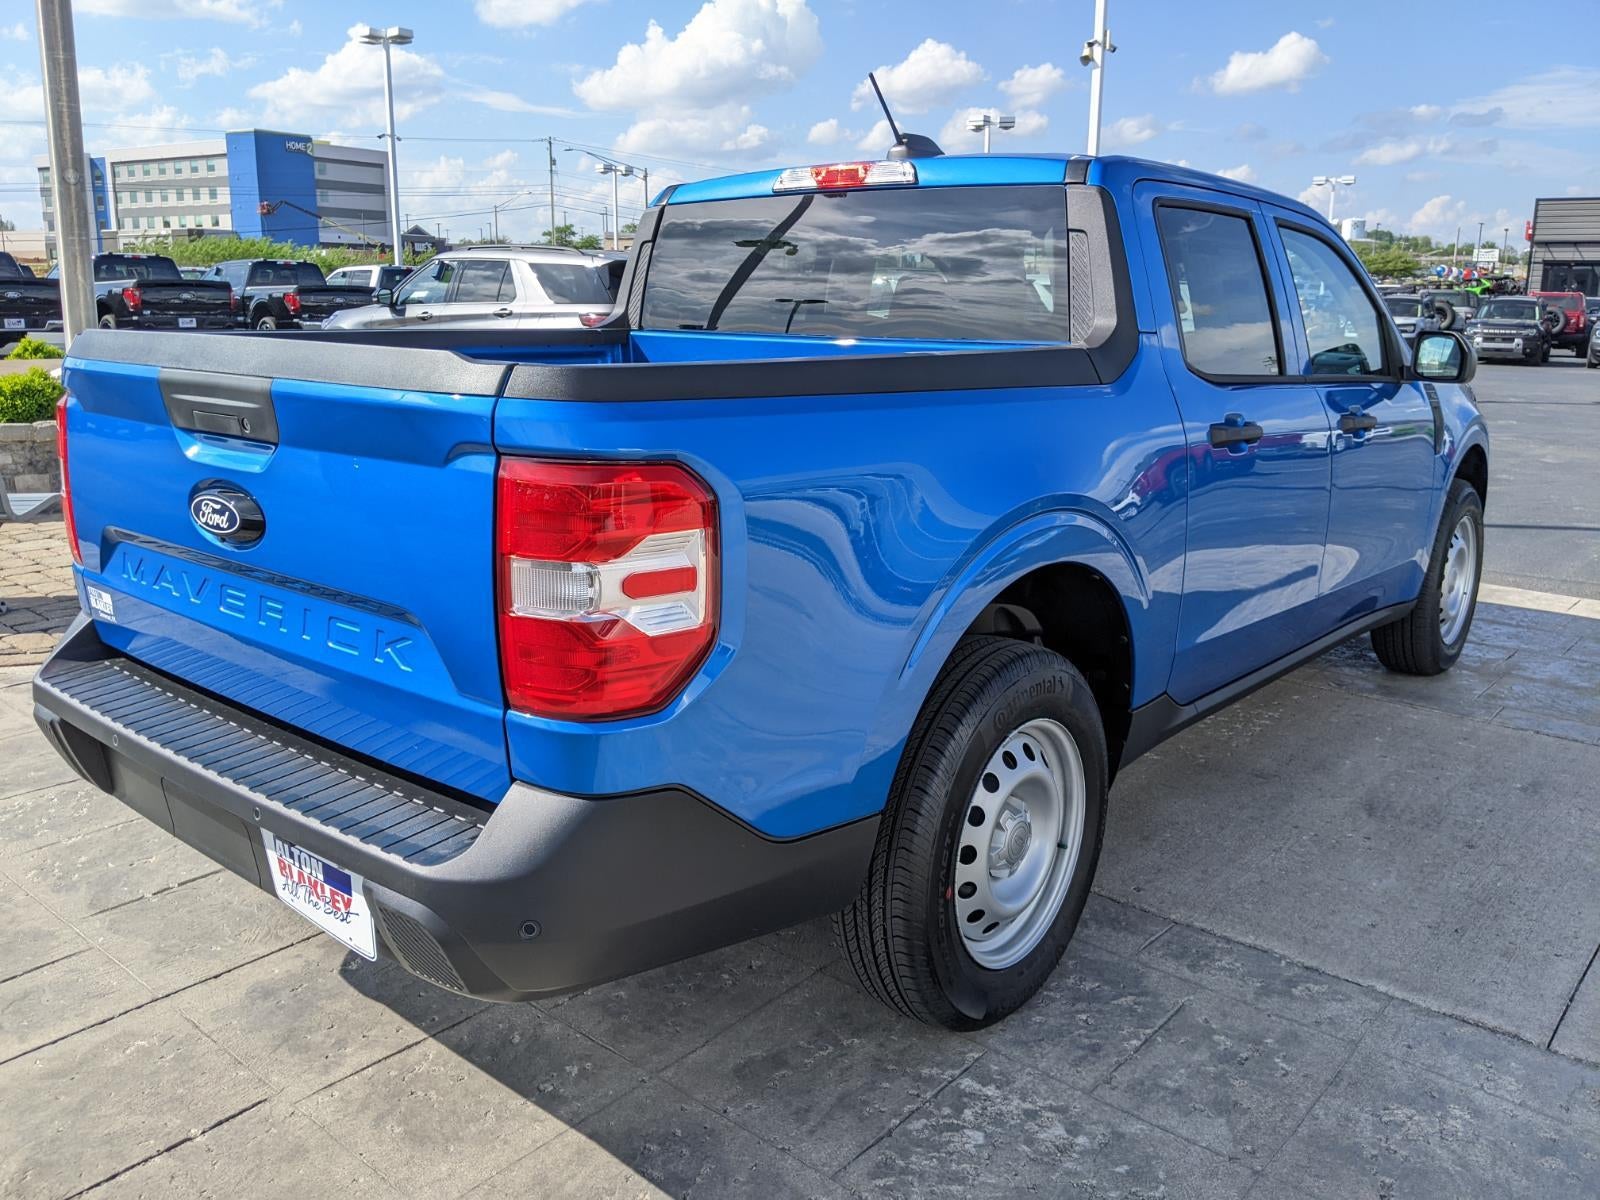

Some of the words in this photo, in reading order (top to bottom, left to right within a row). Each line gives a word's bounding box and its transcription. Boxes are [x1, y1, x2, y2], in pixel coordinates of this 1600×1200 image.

[199, 500, 230, 529] Ford
[121, 551, 414, 673] MAVERICK
[274, 838, 325, 881] ALTON
[299, 884, 322, 911] The
[320, 895, 359, 925] Best
